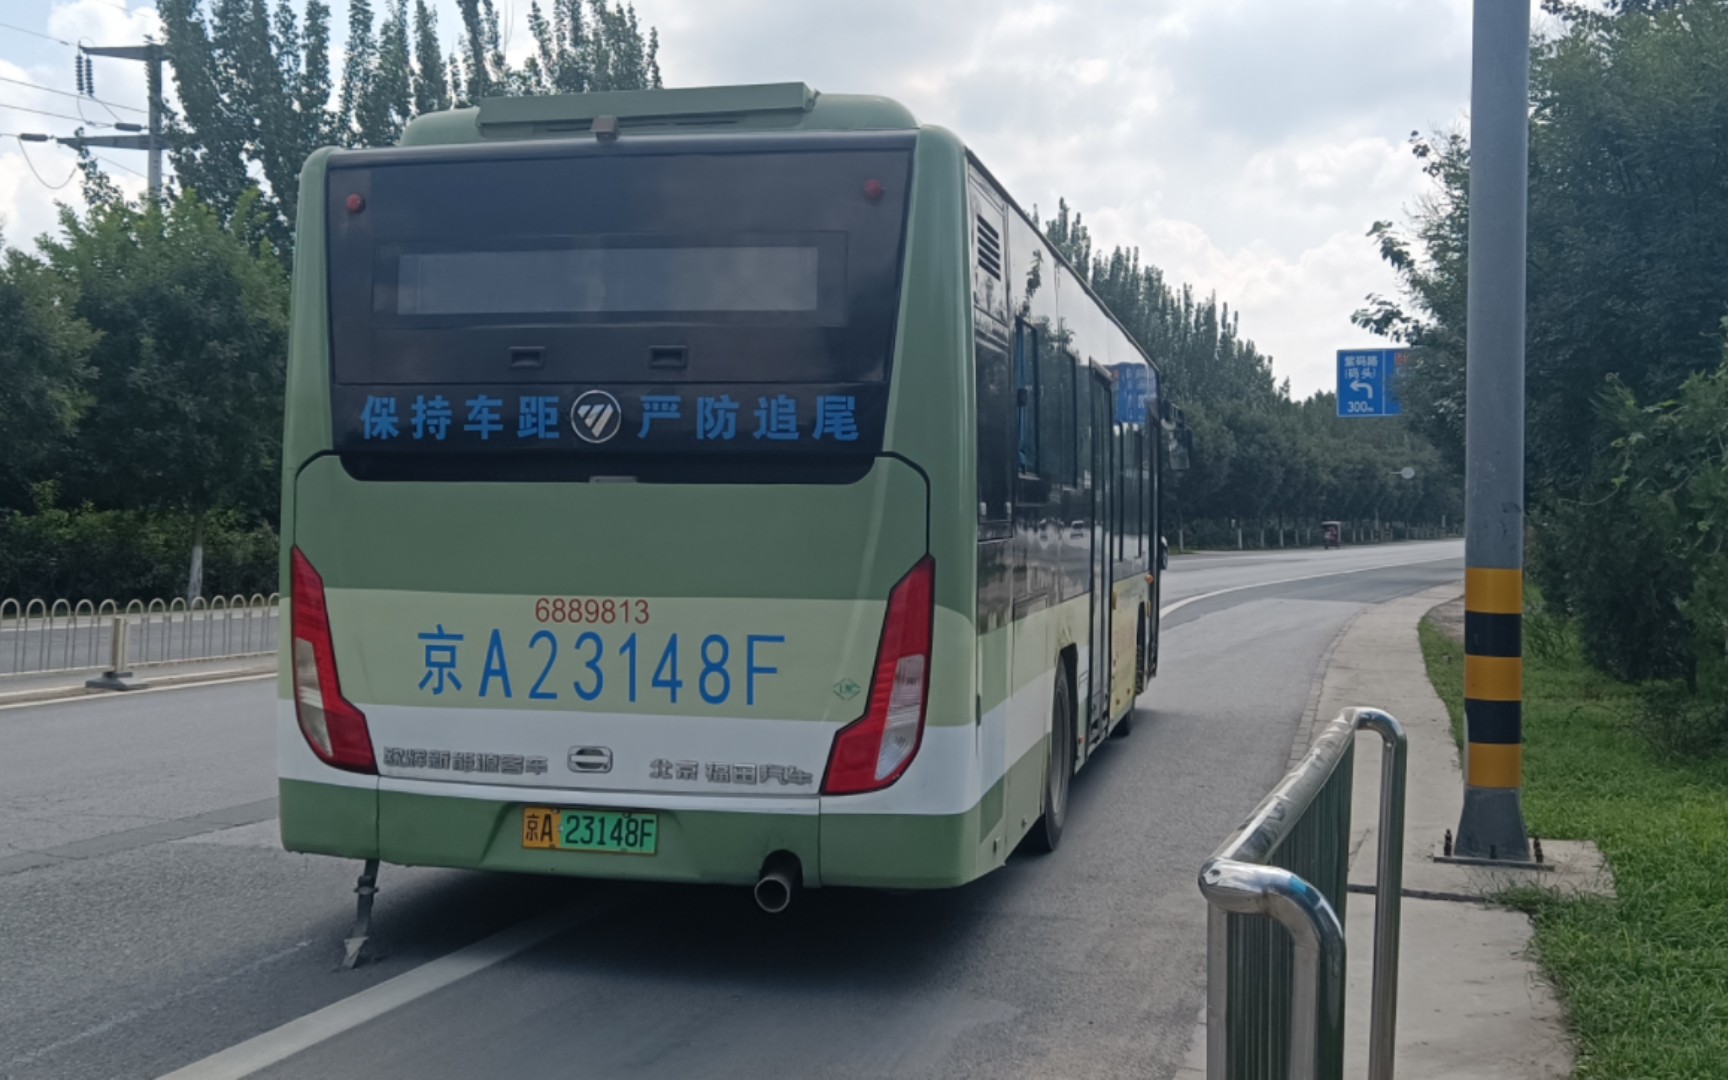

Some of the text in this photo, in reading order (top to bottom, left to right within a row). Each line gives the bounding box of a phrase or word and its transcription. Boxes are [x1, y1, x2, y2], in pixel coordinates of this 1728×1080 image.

[360, 394, 859, 441] 保持车距 严防追尾
[1347, 401, 1375, 413] 300m
[534, 597, 650, 625] 6889813
[417, 624, 786, 706] 京A23148F
[383, 747, 549, 775] 欧辉新能源客车
